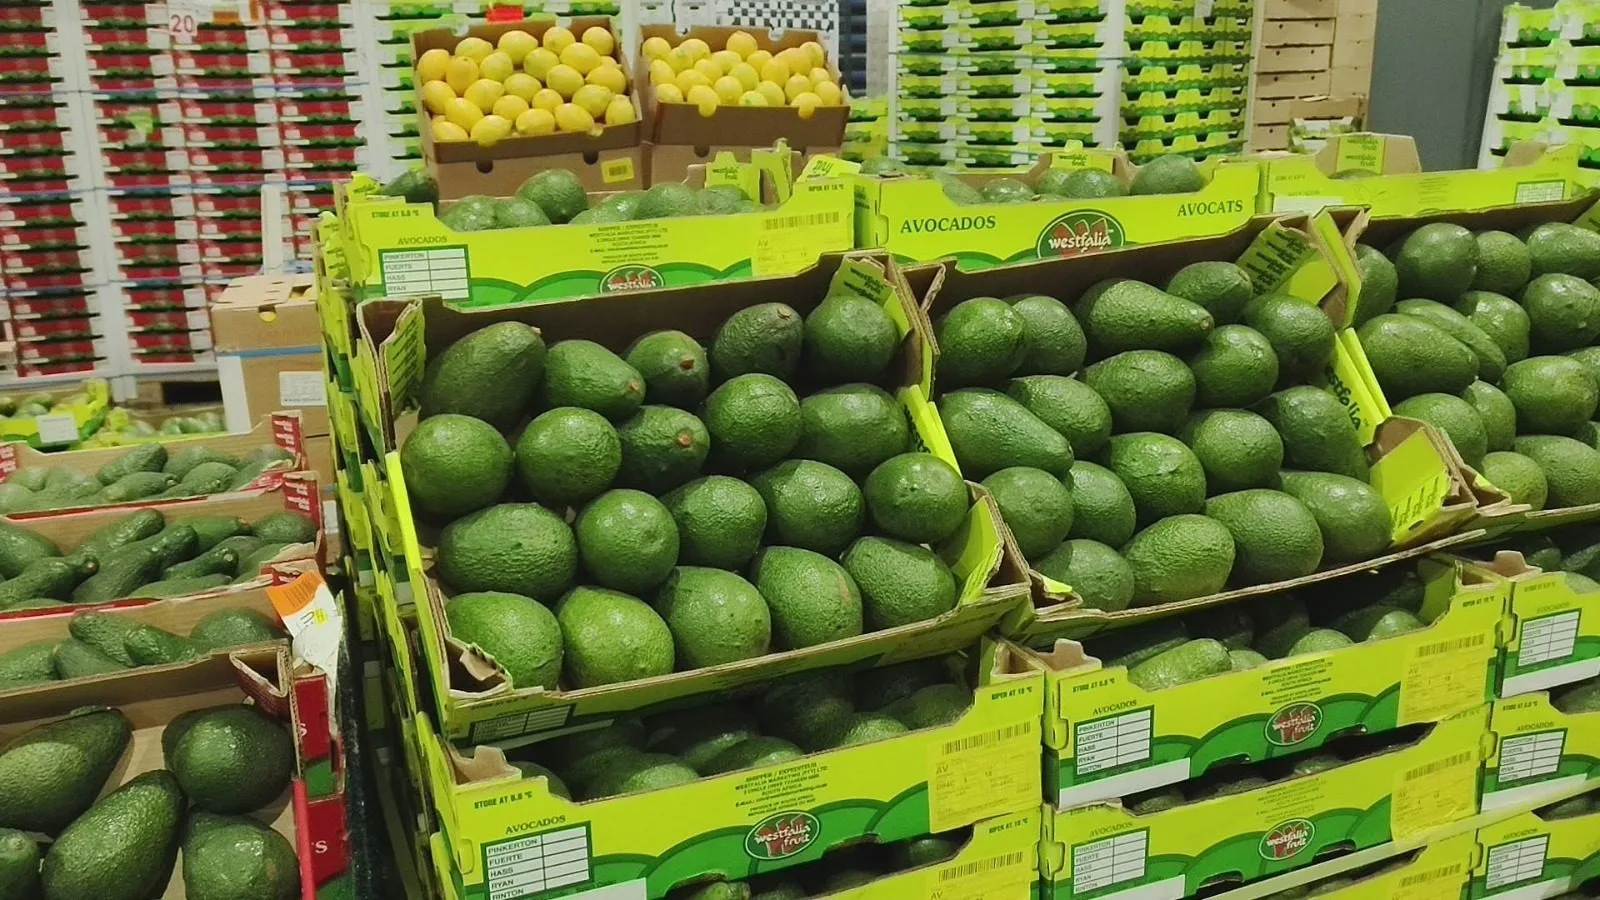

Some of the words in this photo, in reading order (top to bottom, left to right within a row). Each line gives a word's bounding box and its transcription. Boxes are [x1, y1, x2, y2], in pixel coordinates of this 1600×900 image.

[170, 14, 194, 33] 20
[1177, 200, 1243, 216] AVOCATS
[900, 215, 996, 234] AVOCADOS
[397, 236, 448, 245] AVOCADOS
[1048, 231, 1112, 250] westfalia
[992, 692, 1008, 700] RIPEN
[1008, 690, 1016, 698] AT
[1092, 700, 1138, 716] AVOCADOS
[1078, 720, 1115, 732] PINKERTON
[1272, 713, 1316, 731] westfalia
[1294, 722, 1314, 734] fruit
[1078, 732, 1104, 743] FUERTE
[1078, 744, 1096, 753] HASS
[1078, 756, 1096, 764] RYAN
[474, 799, 498, 810] STORE
[499, 796, 508, 805] AT
[505, 815, 566, 834] AVOCADOS
[1089, 822, 1134, 838] AVOCADOS
[754, 823, 811, 844] westfalia
[784, 833, 810, 846] fruit
[1266, 830, 1308, 847] westfalia
[488, 838, 538, 855] PINKERTON
[1286, 838, 1307, 850] fruit
[489, 854, 522, 867] FUERTE
[490, 868, 514, 878] HASS
[491, 879, 514, 890] RYAN
[492, 888, 524, 900] RINTON
